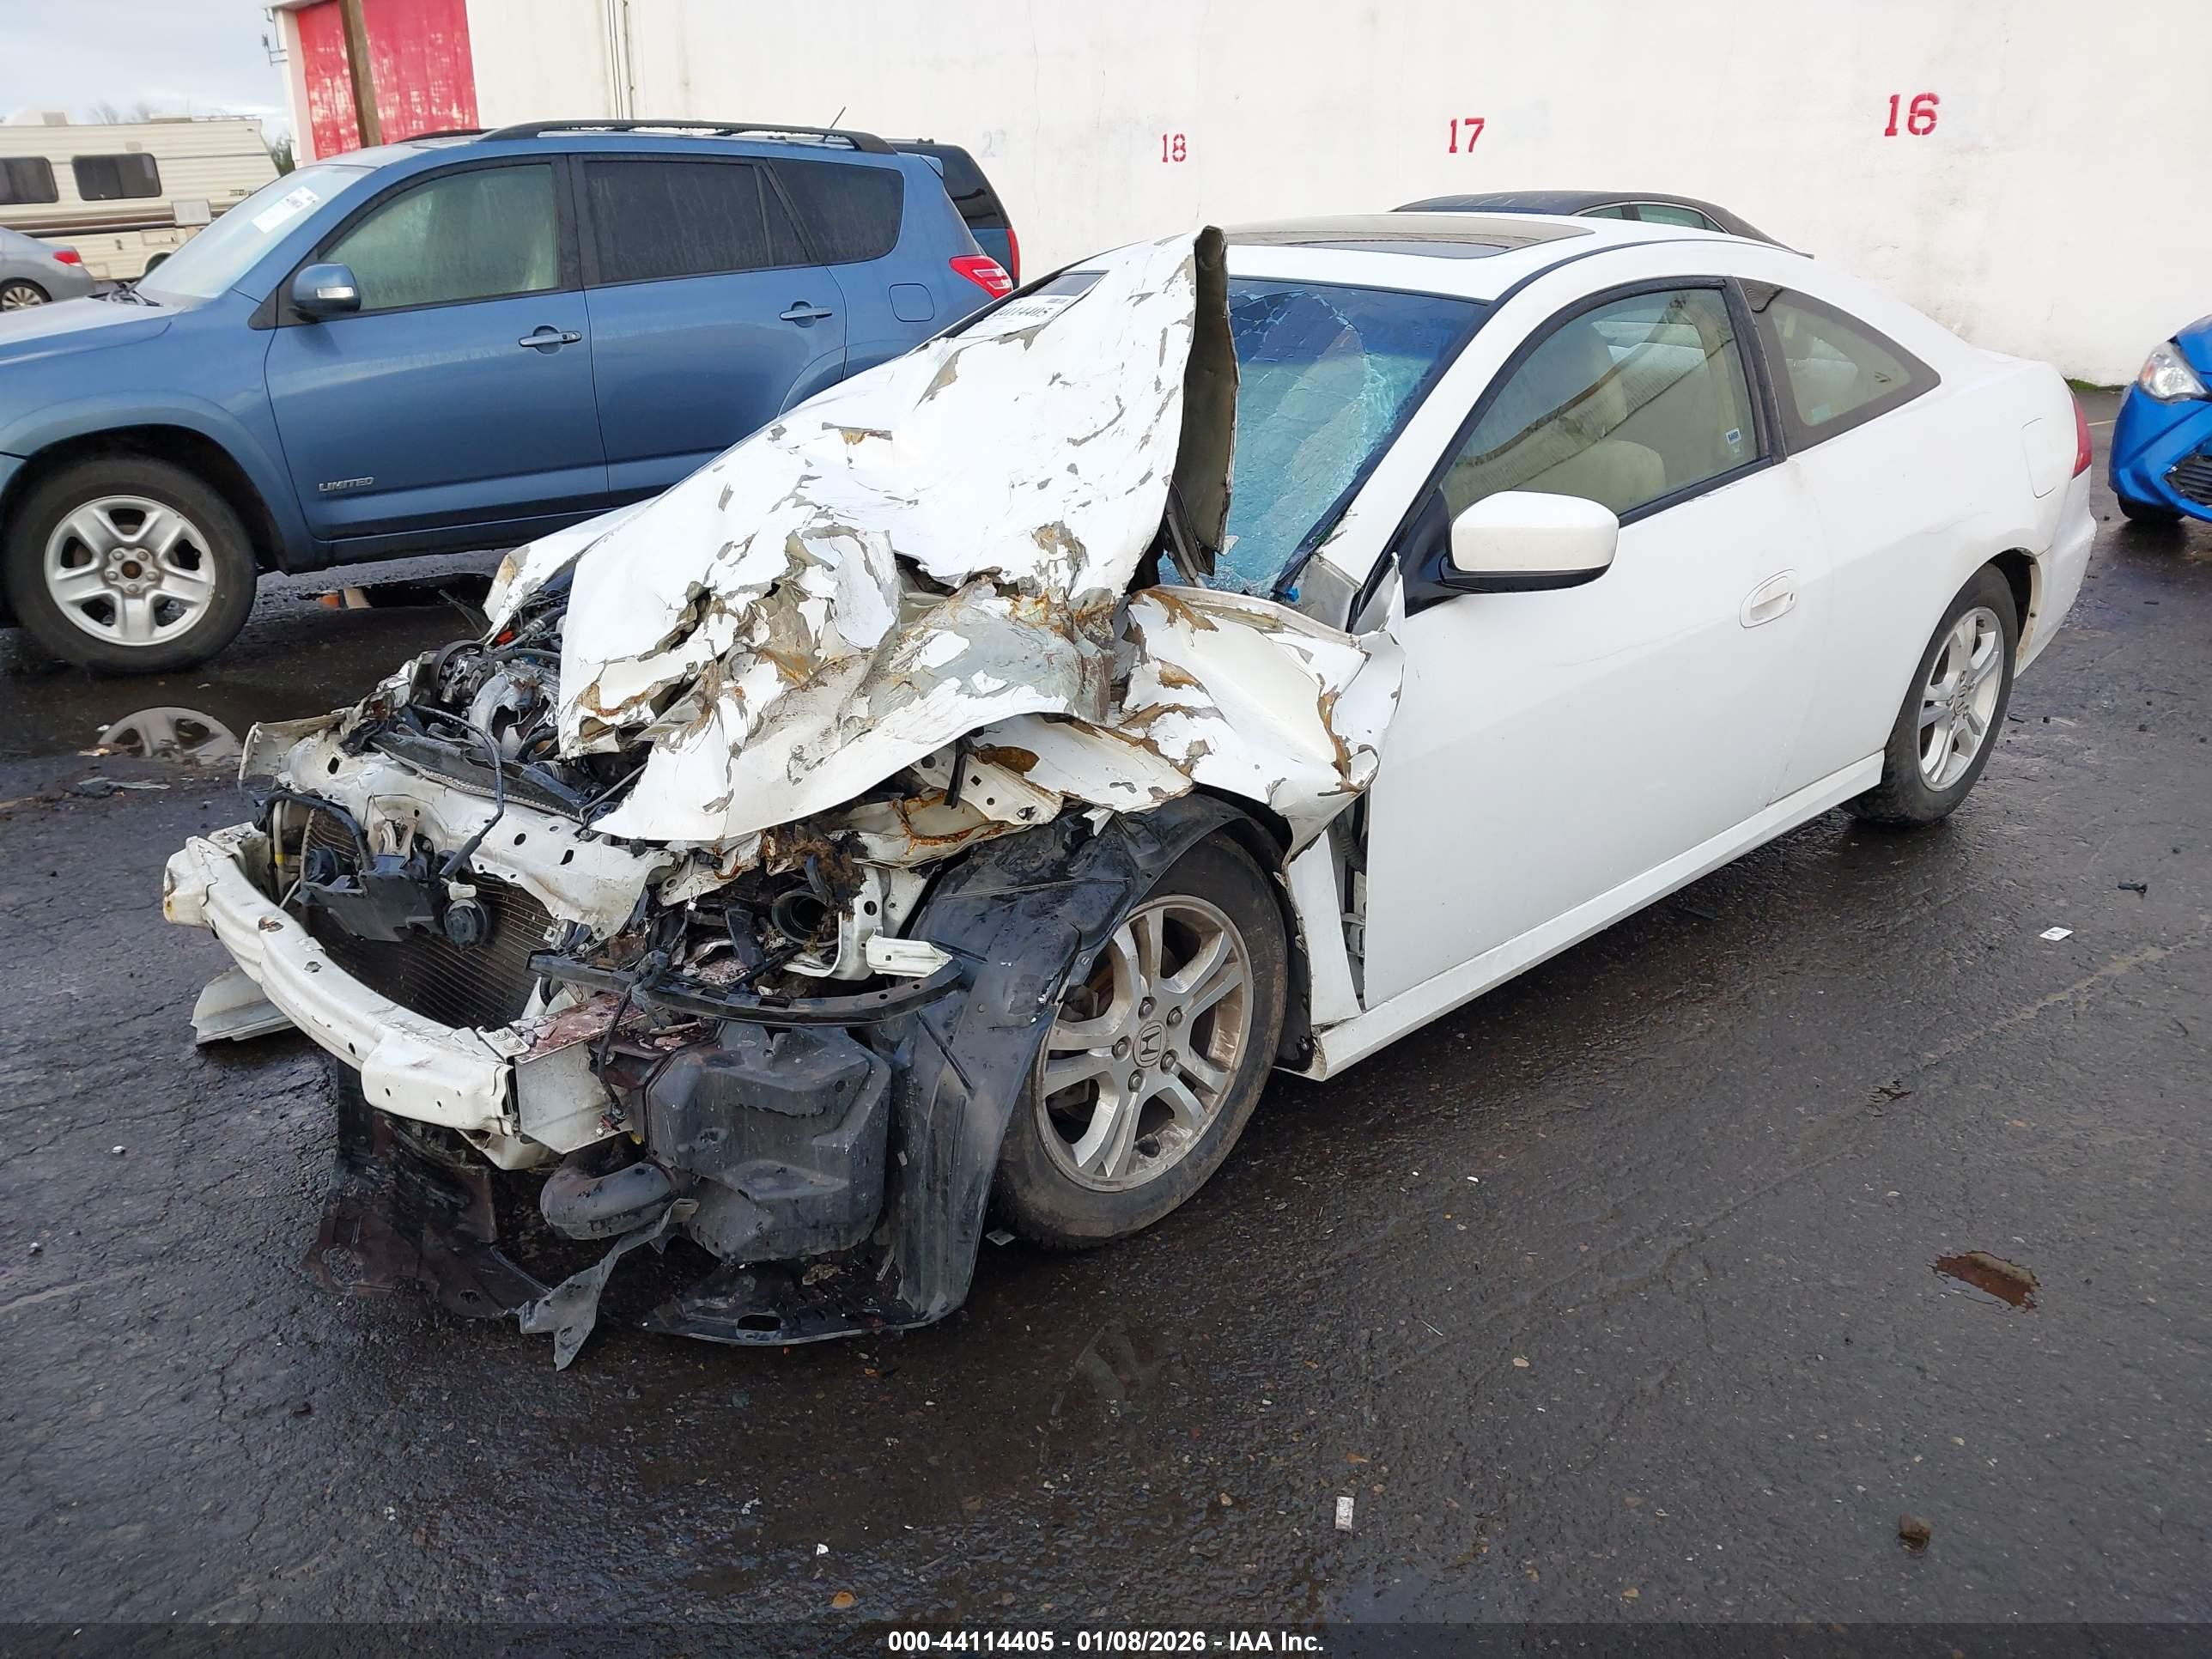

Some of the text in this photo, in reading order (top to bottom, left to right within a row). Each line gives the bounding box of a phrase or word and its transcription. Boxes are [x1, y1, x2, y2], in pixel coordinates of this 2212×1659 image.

[1884, 92, 1940, 137] 16
[1162, 133, 1187, 163] 18
[1449, 117, 1486, 154] 17
[318, 476, 374, 492] LIMITED
